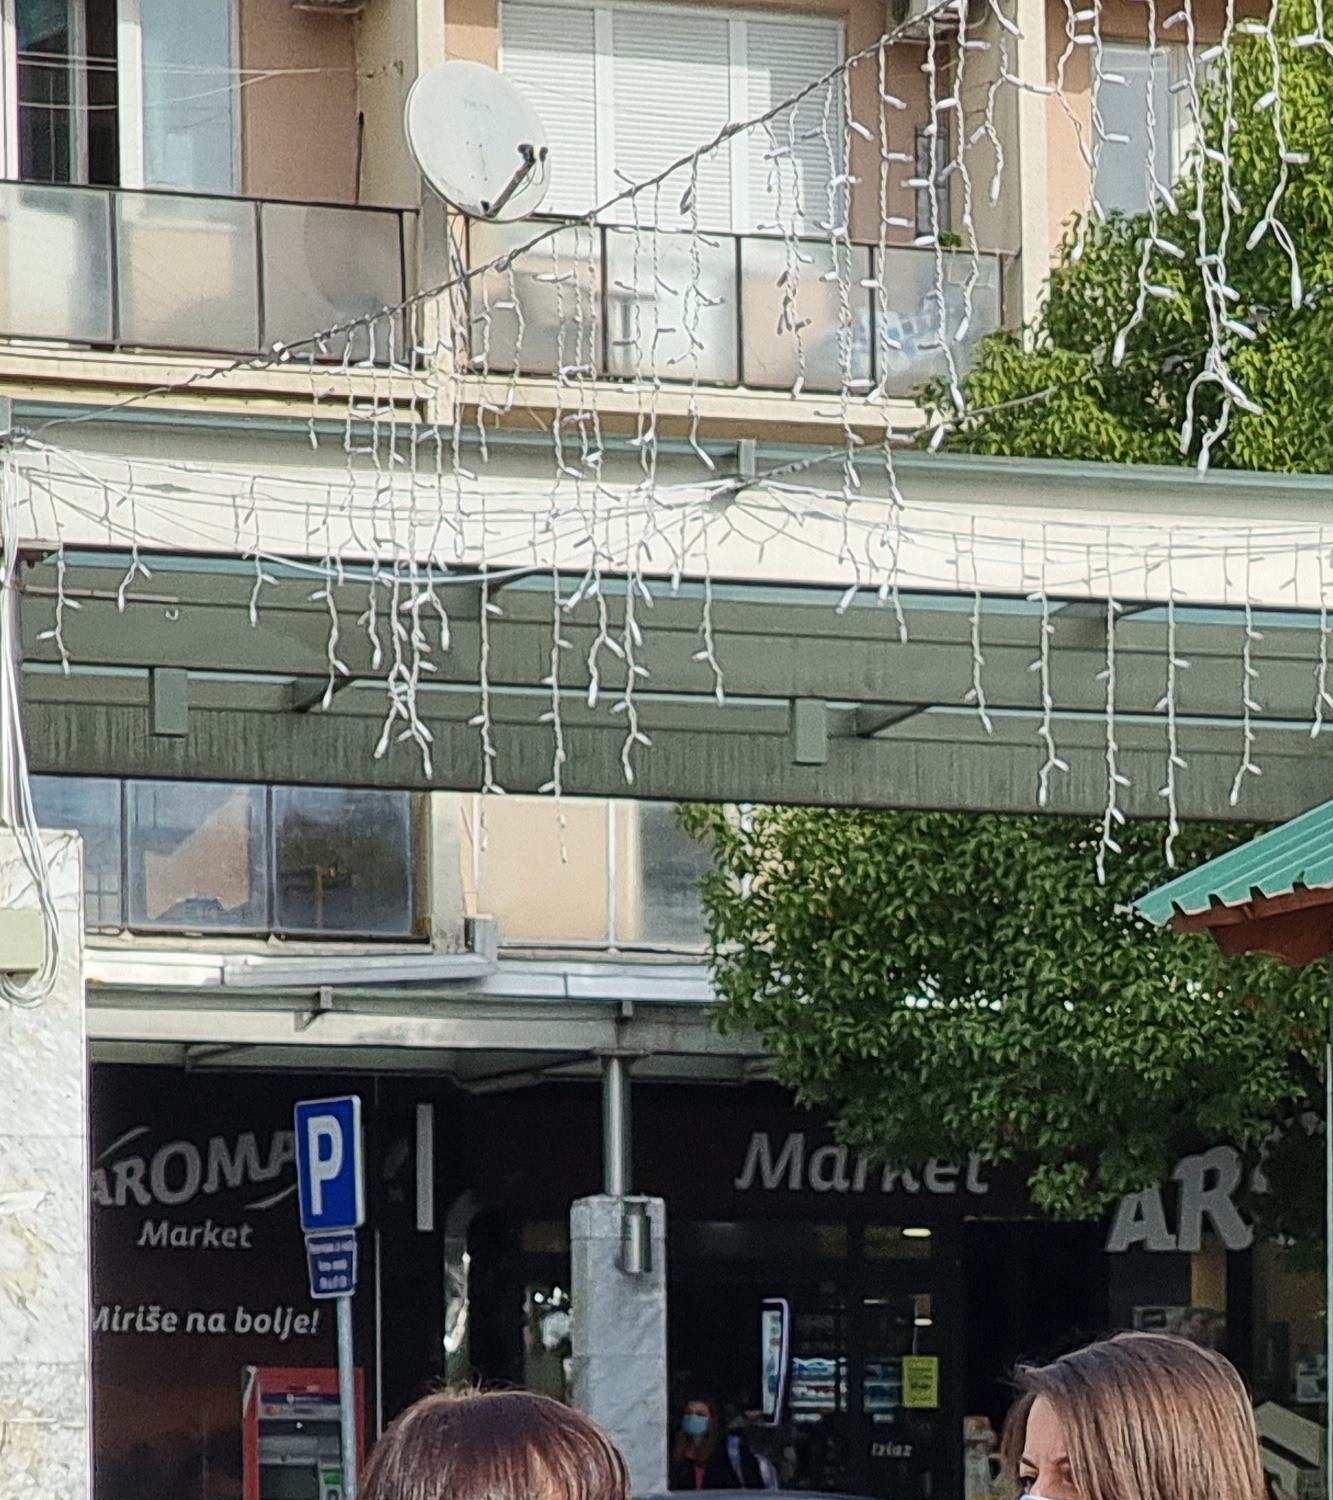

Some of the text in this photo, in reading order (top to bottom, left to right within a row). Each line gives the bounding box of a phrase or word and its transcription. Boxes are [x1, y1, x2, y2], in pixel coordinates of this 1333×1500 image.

[307, 1114, 343, 1215] P
[137, 1219, 253, 1248] Market
[186, 1311, 227, 1333] na
[234, 1306, 320, 1341] bolje!
